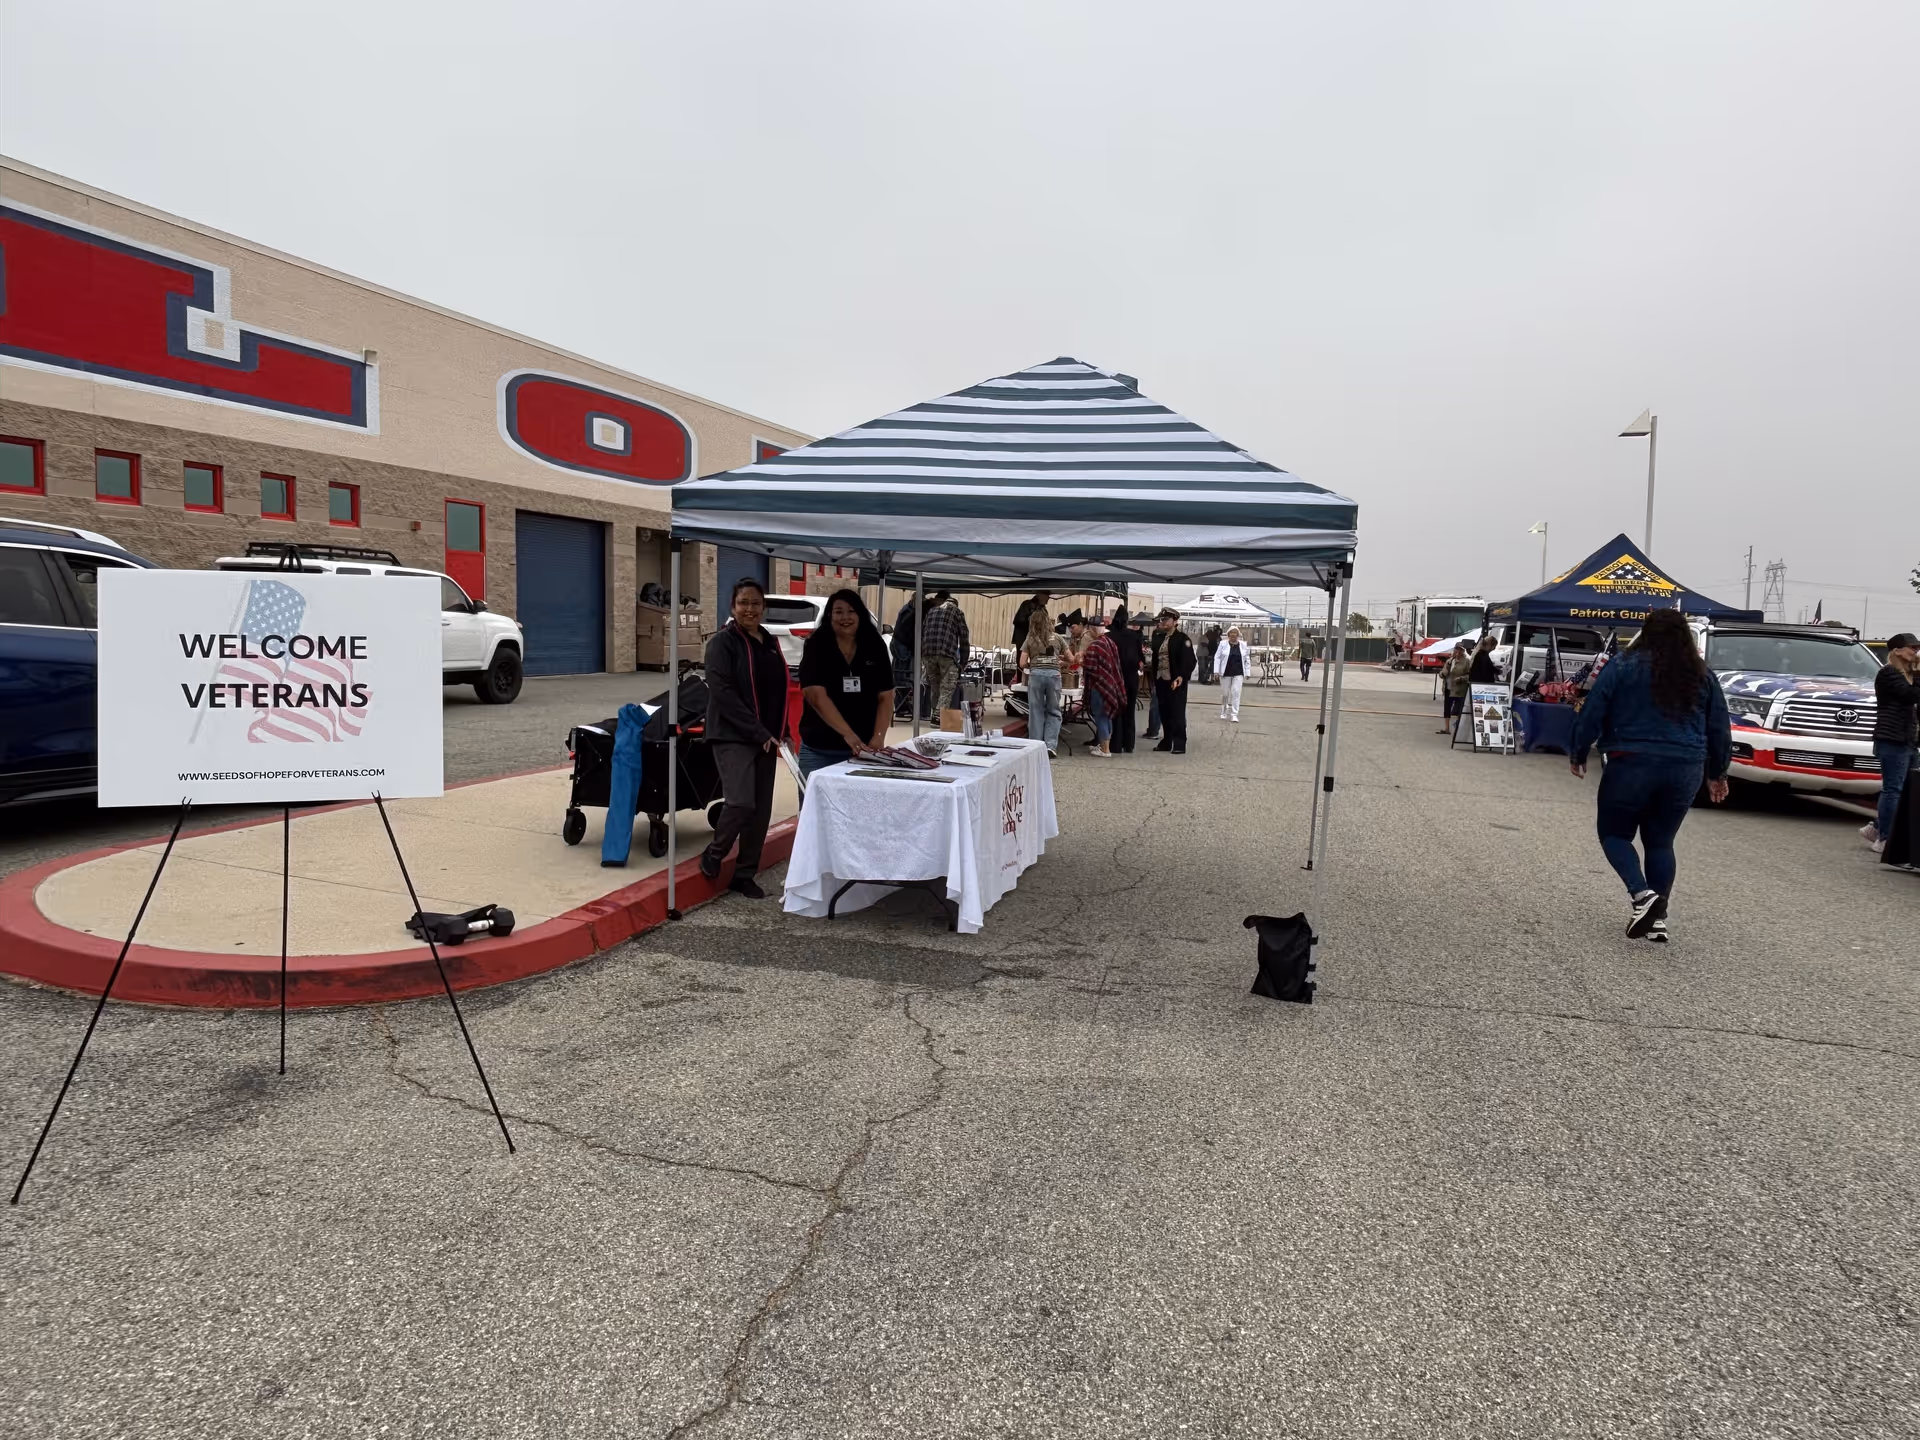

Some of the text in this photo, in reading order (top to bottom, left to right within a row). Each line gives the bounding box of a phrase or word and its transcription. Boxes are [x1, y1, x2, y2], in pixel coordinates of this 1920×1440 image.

[1593, 560, 1661, 580] PATRIOT GUARD
[1570, 608, 1616, 619] Patriot
[179, 633, 368, 660] WELCOME
[181, 683, 369, 709] VETERANS
[177, 768, 386, 781] WWW.SEEDSOFHOPEFORVETERANS.COM
